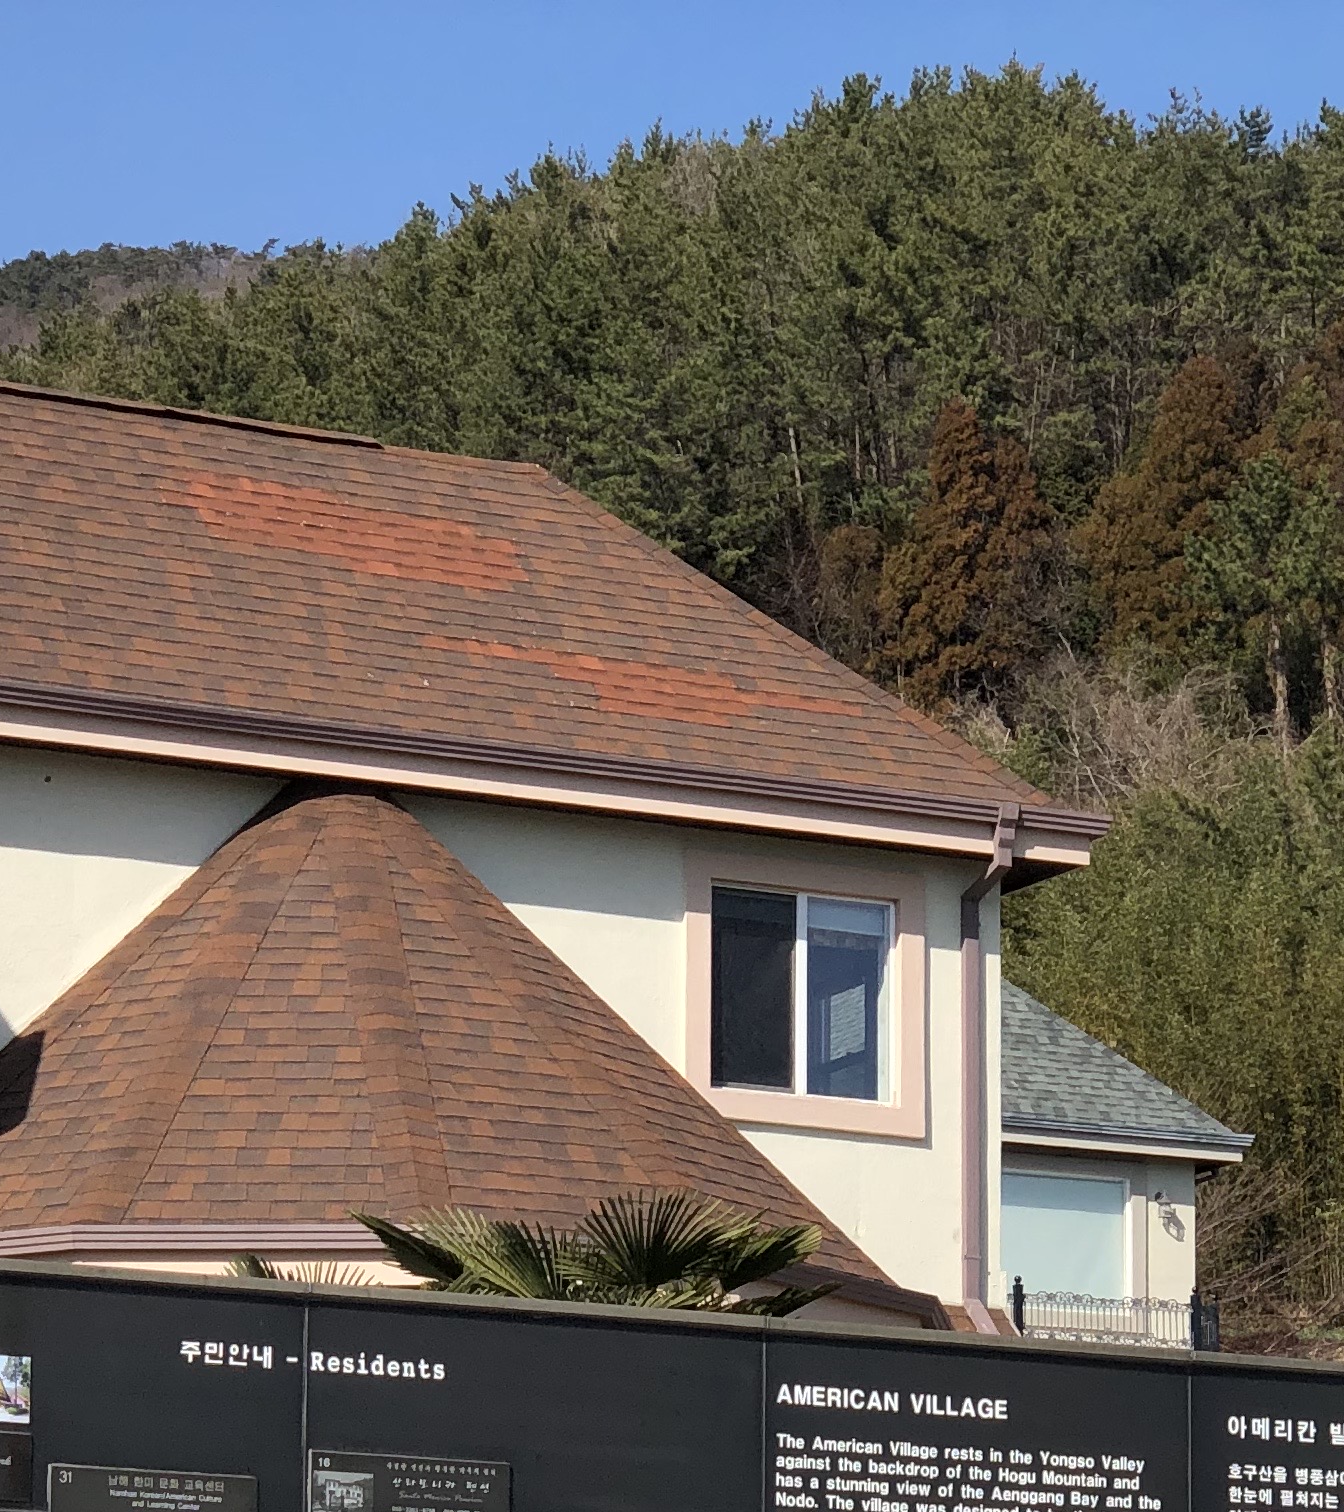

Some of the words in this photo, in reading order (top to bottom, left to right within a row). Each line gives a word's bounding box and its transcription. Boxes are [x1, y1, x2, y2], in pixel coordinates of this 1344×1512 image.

[180, 1341, 272, 1369] 주민안내
[311, 1352, 445, 1379] Residents
[776, 1383, 899, 1413] AMERICAN
[910, 1392, 1008, 1420] VILLAGE
[1227, 1415, 1317, 1443] 아메리칸
[776, 1432, 805, 1450] The
[811, 1435, 883, 1455] American
[889, 1440, 938, 1460] Village
[944, 1446, 984, 1462] rests
[989, 1447, 1003, 1463] in
[1009, 1449, 1033, 1465] the
[1039, 1450, 1095, 1470] Yongso
[1101, 1454, 1145, 1474] Valley
[59, 1471, 72, 1483] 31
[1227, 1463, 1288, 1484] 호구산을
[775, 1491, 819, 1509] Nodo.
[825, 1494, 855, 1511] The
